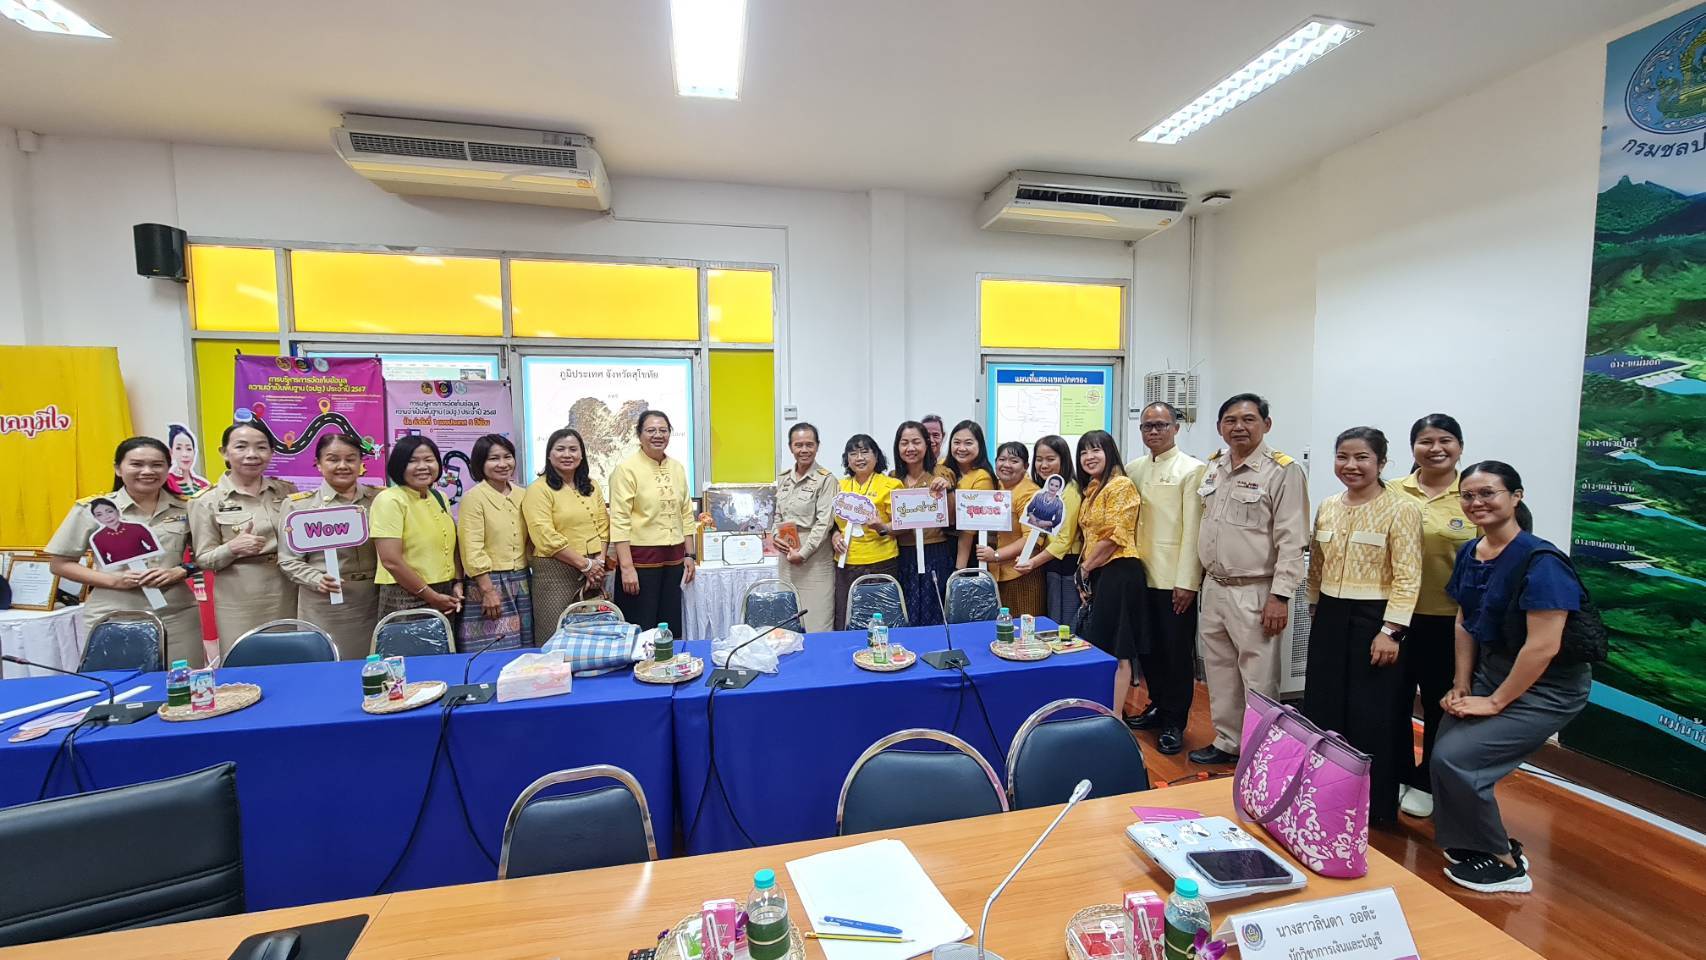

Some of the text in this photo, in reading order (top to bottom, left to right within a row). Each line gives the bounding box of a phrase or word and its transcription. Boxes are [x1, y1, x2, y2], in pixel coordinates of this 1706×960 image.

[268, 376, 348, 386] การบริหารการจัดเก็บข้อมูล
[560, 368, 659, 382] ภูมิประเทศ จังหวัดสุโขทัย
[1014, 371, 1088, 384] แผนที่แสดงเขตปกครอง
[409, 399, 480, 409] การบริหารการจัดเก็บข้อมูล
[304, 521, 350, 539] Wow
[1276, 914, 1344, 938] นางสาวลินดา
[1288, 931, 1383, 960] นักวิชาการเงินและบัญชี
